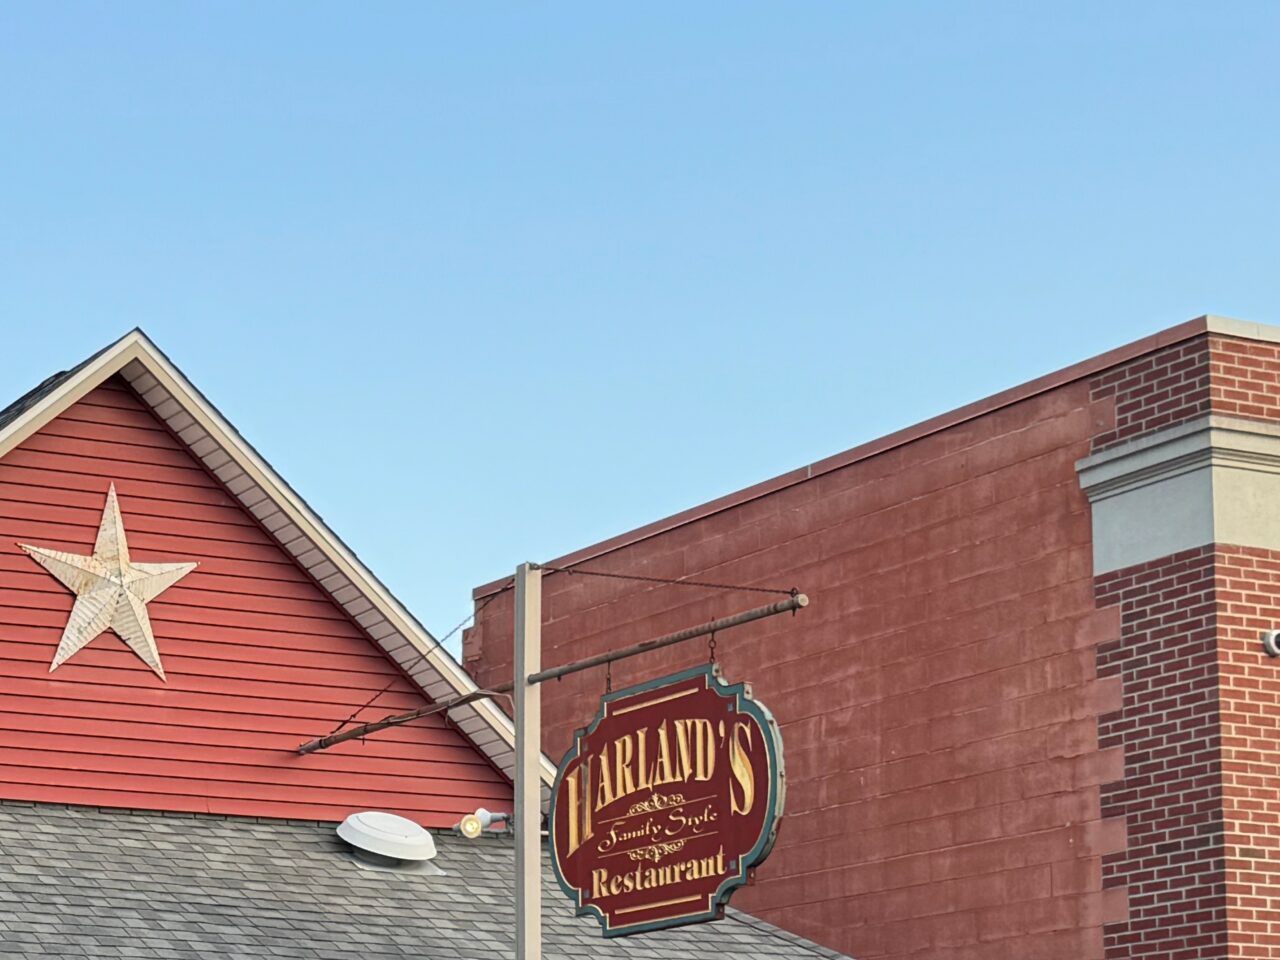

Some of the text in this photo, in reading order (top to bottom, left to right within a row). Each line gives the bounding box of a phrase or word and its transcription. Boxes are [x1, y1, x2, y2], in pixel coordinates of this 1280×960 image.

[566, 718, 755, 858] HARLAND'S
[597, 804, 718, 852] Family Style
[592, 844, 727, 899] Restaurant
